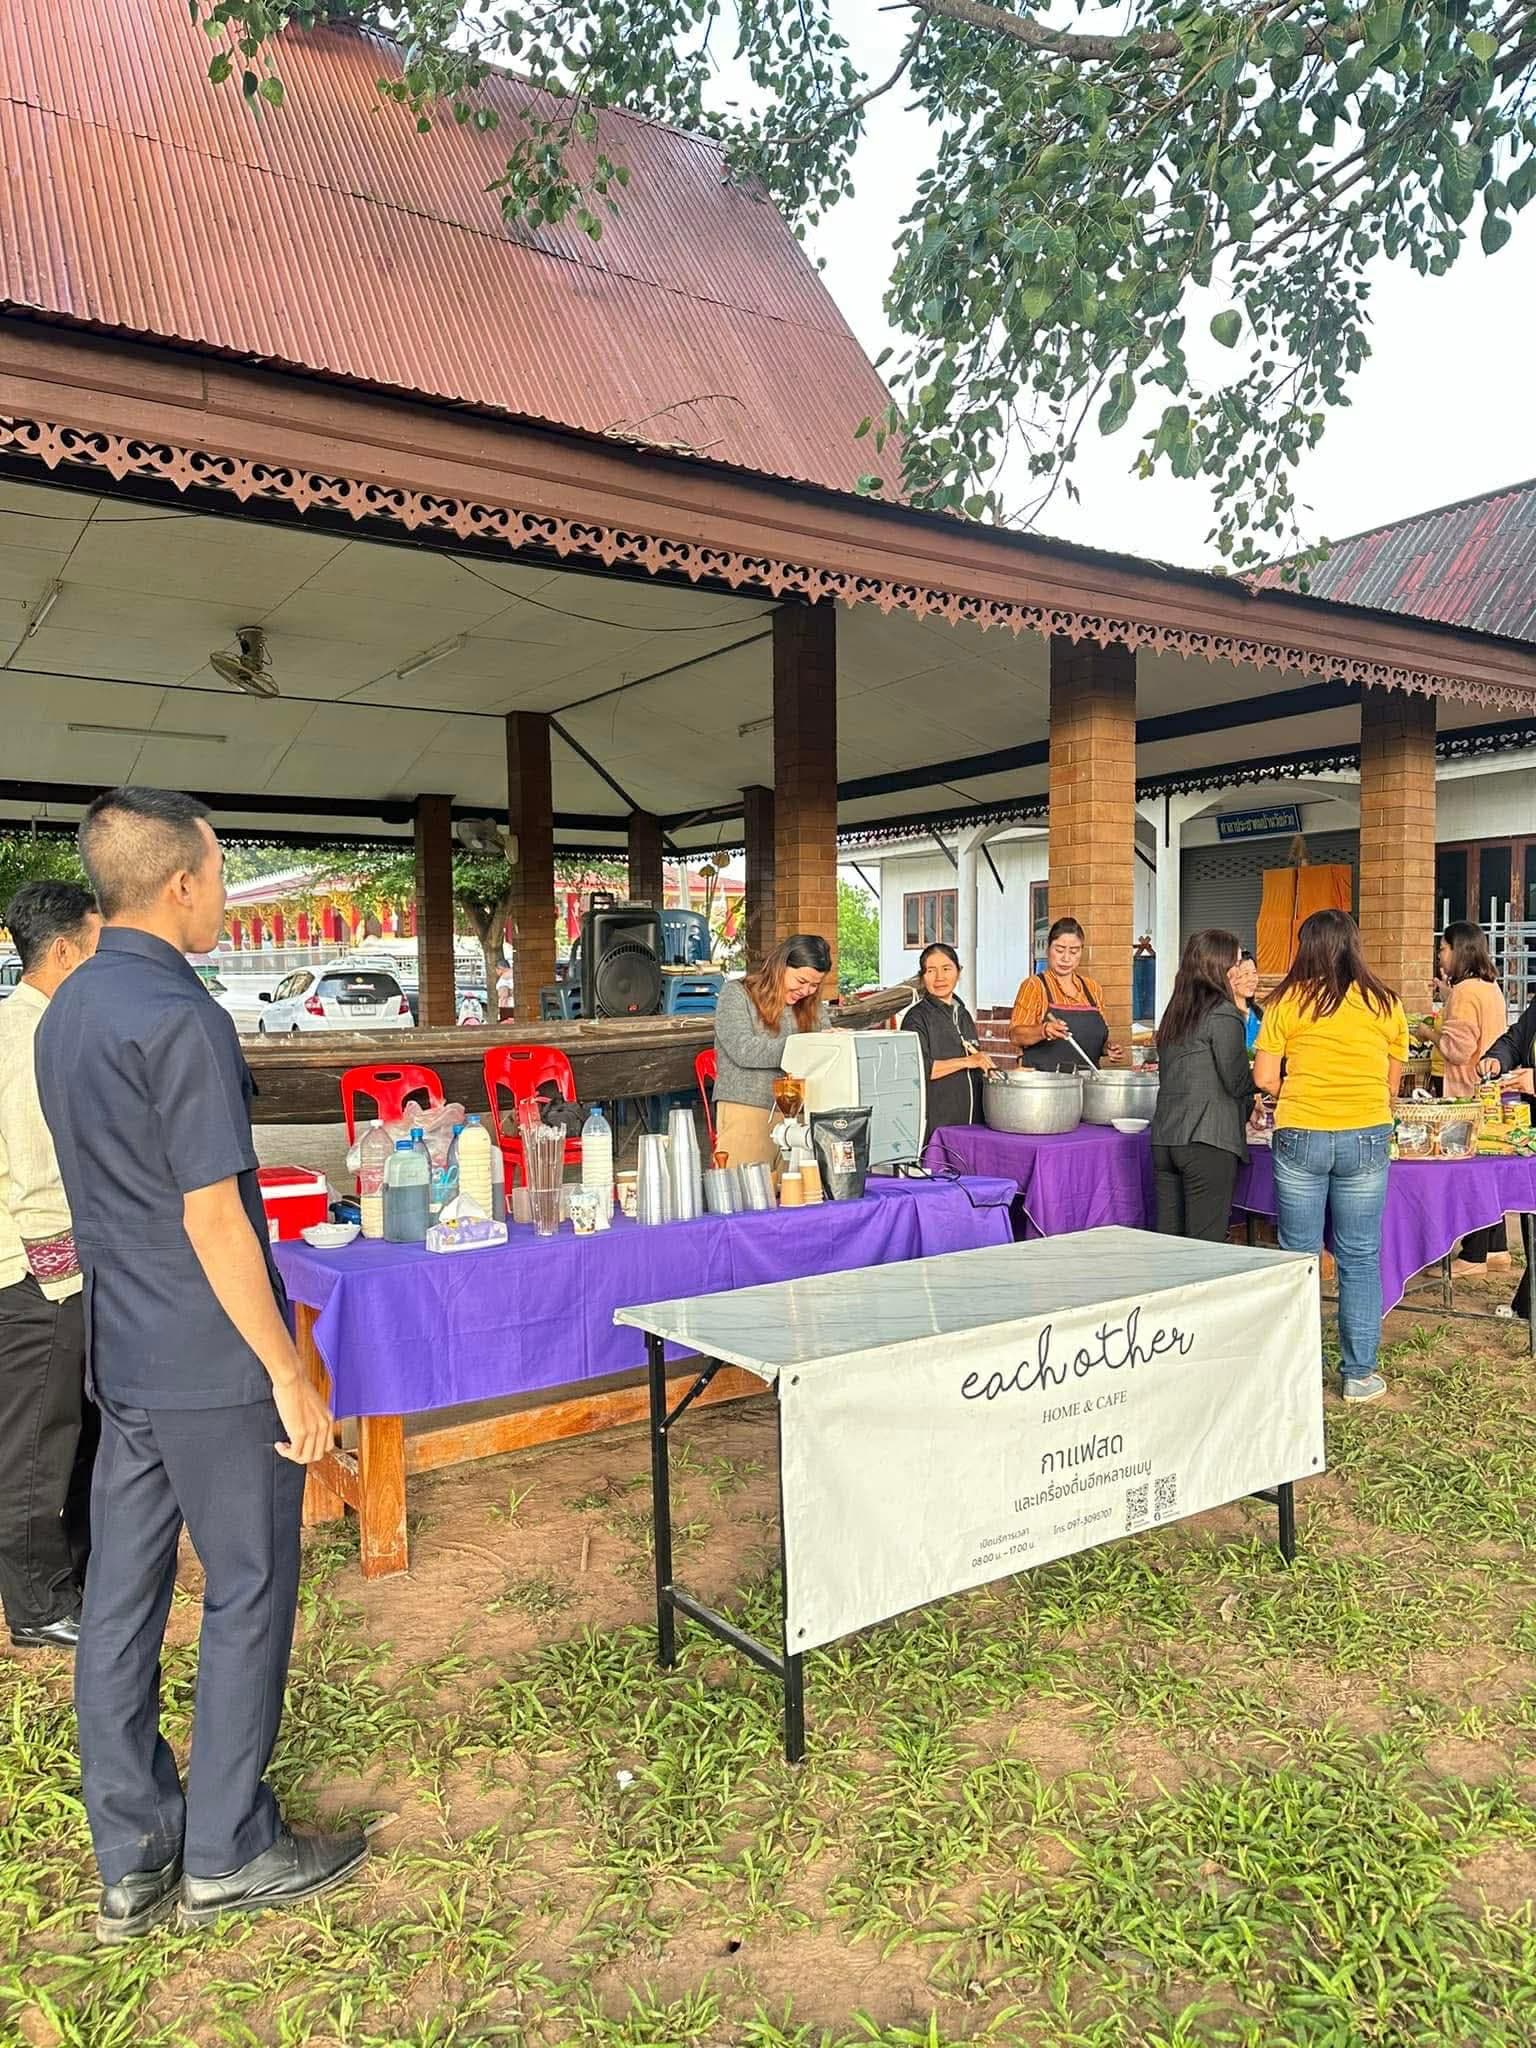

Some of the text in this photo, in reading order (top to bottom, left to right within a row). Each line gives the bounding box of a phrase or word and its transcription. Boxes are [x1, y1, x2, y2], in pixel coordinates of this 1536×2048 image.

[961, 1306, 1195, 1400] each other
[1042, 1390, 1128, 1424] HOME & CAFE
[1041, 1434, 1123, 1475] กาแฟสด
[1014, 1459, 1152, 1512] และเครื่องดื่มอีกหลายเมนู
